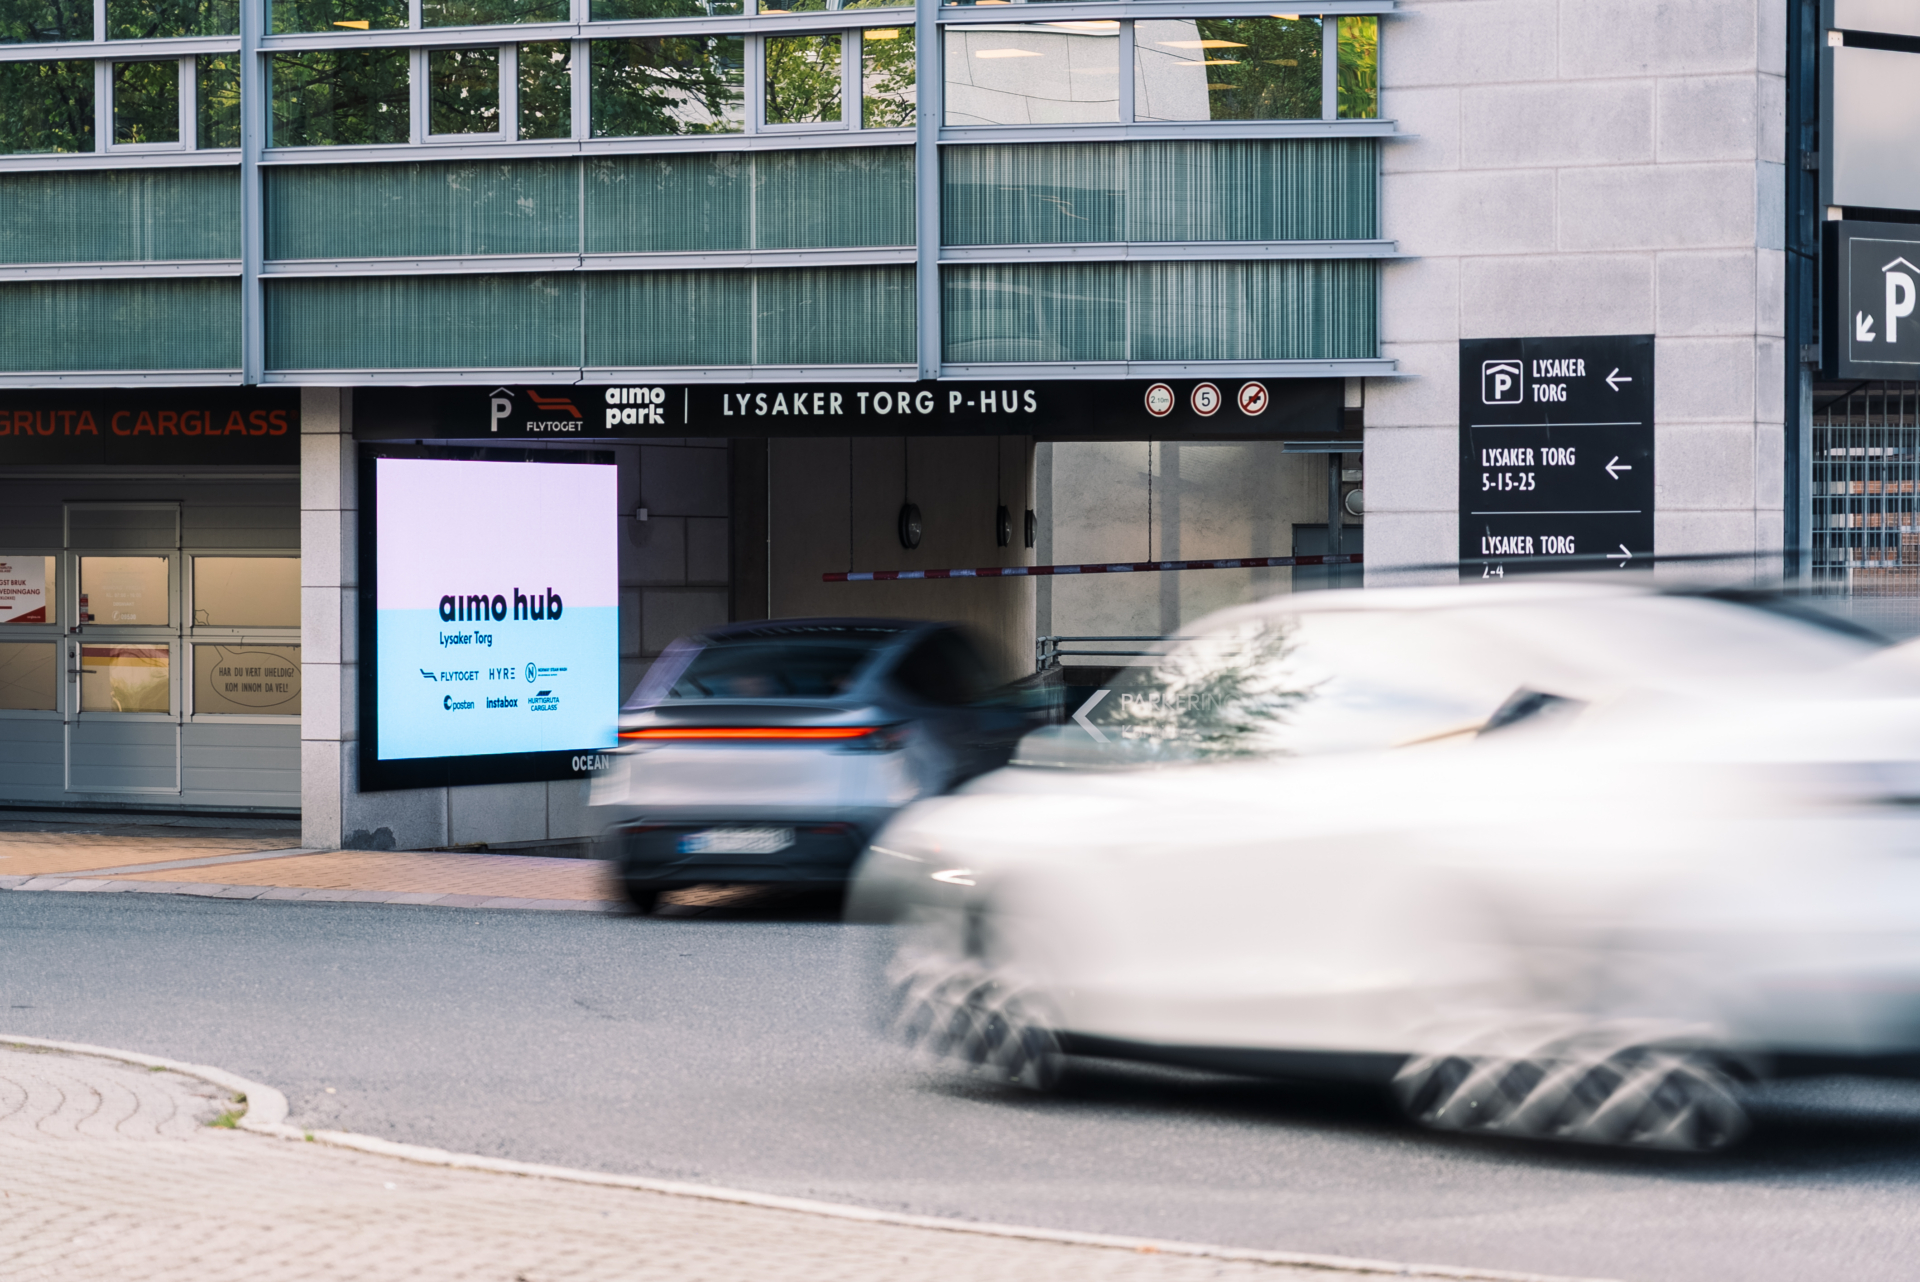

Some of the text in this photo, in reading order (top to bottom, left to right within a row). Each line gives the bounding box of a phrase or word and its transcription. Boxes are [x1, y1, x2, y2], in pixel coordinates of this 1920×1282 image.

[1532, 359, 1586, 378] LYSAKER
[605, 387, 666, 405] aimo
[1201, 391, 1211, 407] 5
[1532, 383, 1567, 403] TORG
[722, 389, 1038, 416] LYSAKER TORG P-HUS
[111, 410, 289, 436] CARGLASS
[605, 404, 666, 429] park
[526, 421, 583, 432] FLYTOGET
[1482, 447, 1576, 467] LYSAKER TORG
[1482, 472, 1536, 491] 5-15-25
[1482, 535, 1575, 555] LYSAKER TORG
[1482, 561, 1505, 579] 2-4
[438, 587, 563, 623] aimo hub
[439, 631, 493, 648] Lysaker Torg
[218, 667, 295, 678] HAR DU VÆRT UHELDIG?
[440, 670, 480, 682] FLYTOGET
[489, 667, 516, 680] HYRE
[224, 682, 289, 693] KOM INNOM DA VEL!
[452, 699, 475, 712] posten
[486, 695, 518, 709] instabox
[571, 754, 610, 772] OCEAN
